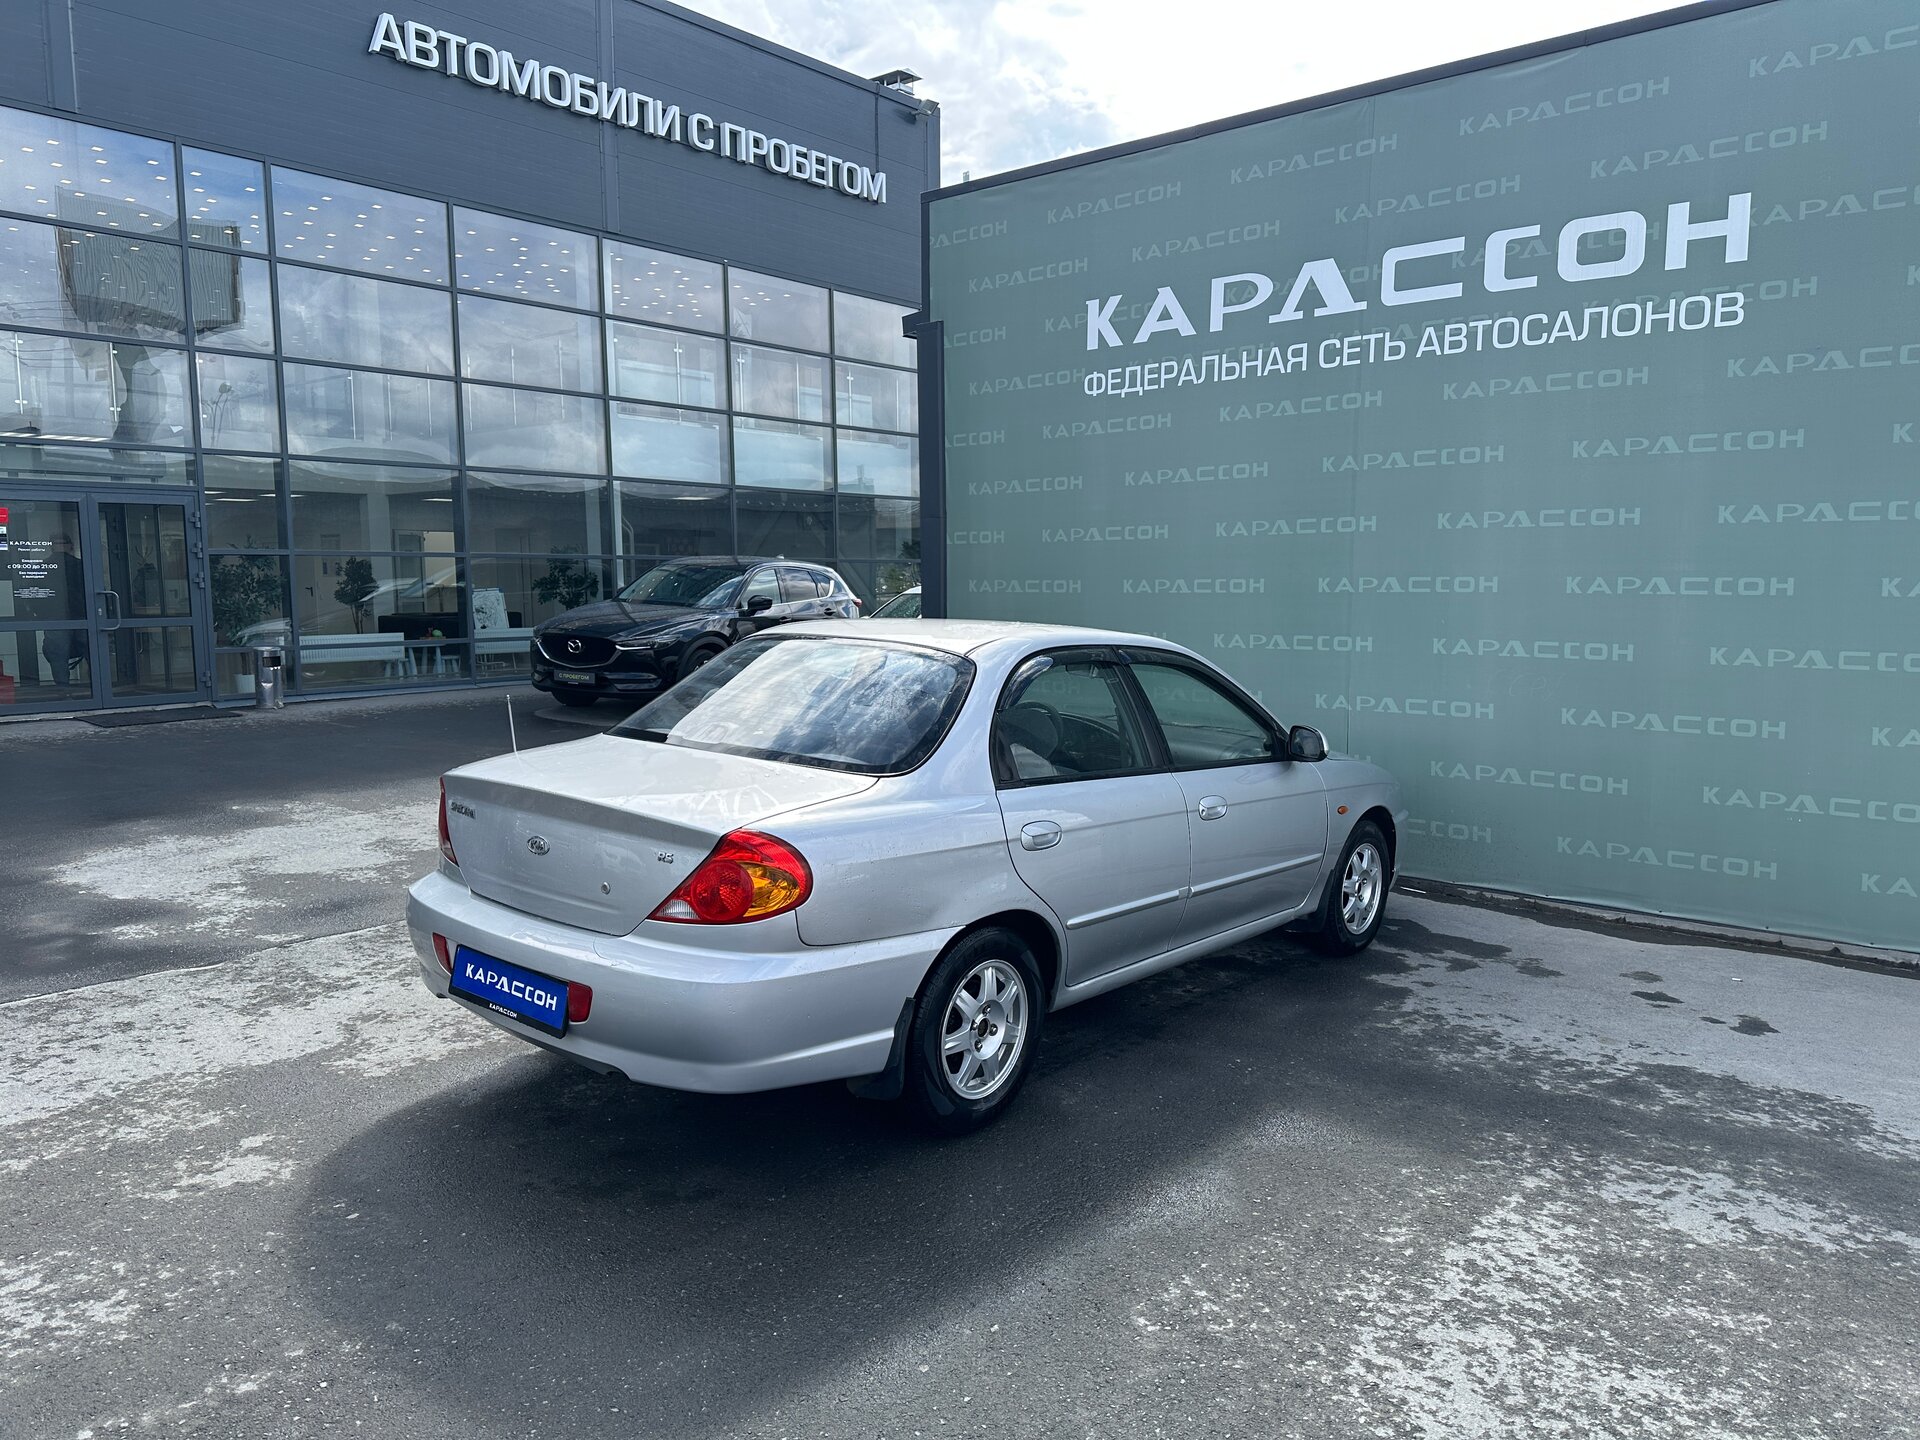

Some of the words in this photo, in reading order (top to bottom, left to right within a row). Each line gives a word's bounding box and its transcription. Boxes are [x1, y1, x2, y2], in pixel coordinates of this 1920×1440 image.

[368, 12, 681, 143] АВТОМОБИЛИ
[688, 112, 715, 152] С
[720, 121, 887, 204] ПРОБЕГОМ
[1085, 192, 1752, 350] КАРАССОН
[1084, 343, 1307, 398] ФЕДЕРАЛЬНАЯ
[1319, 332, 1406, 369] СЕТЬ
[1416, 291, 1745, 357] АВТОСАЛОНОВ
[1718, 501, 1920, 524] КАРАСС
[657, 851, 675, 864] RS
[465, 962, 557, 1011] КАРАССОН
